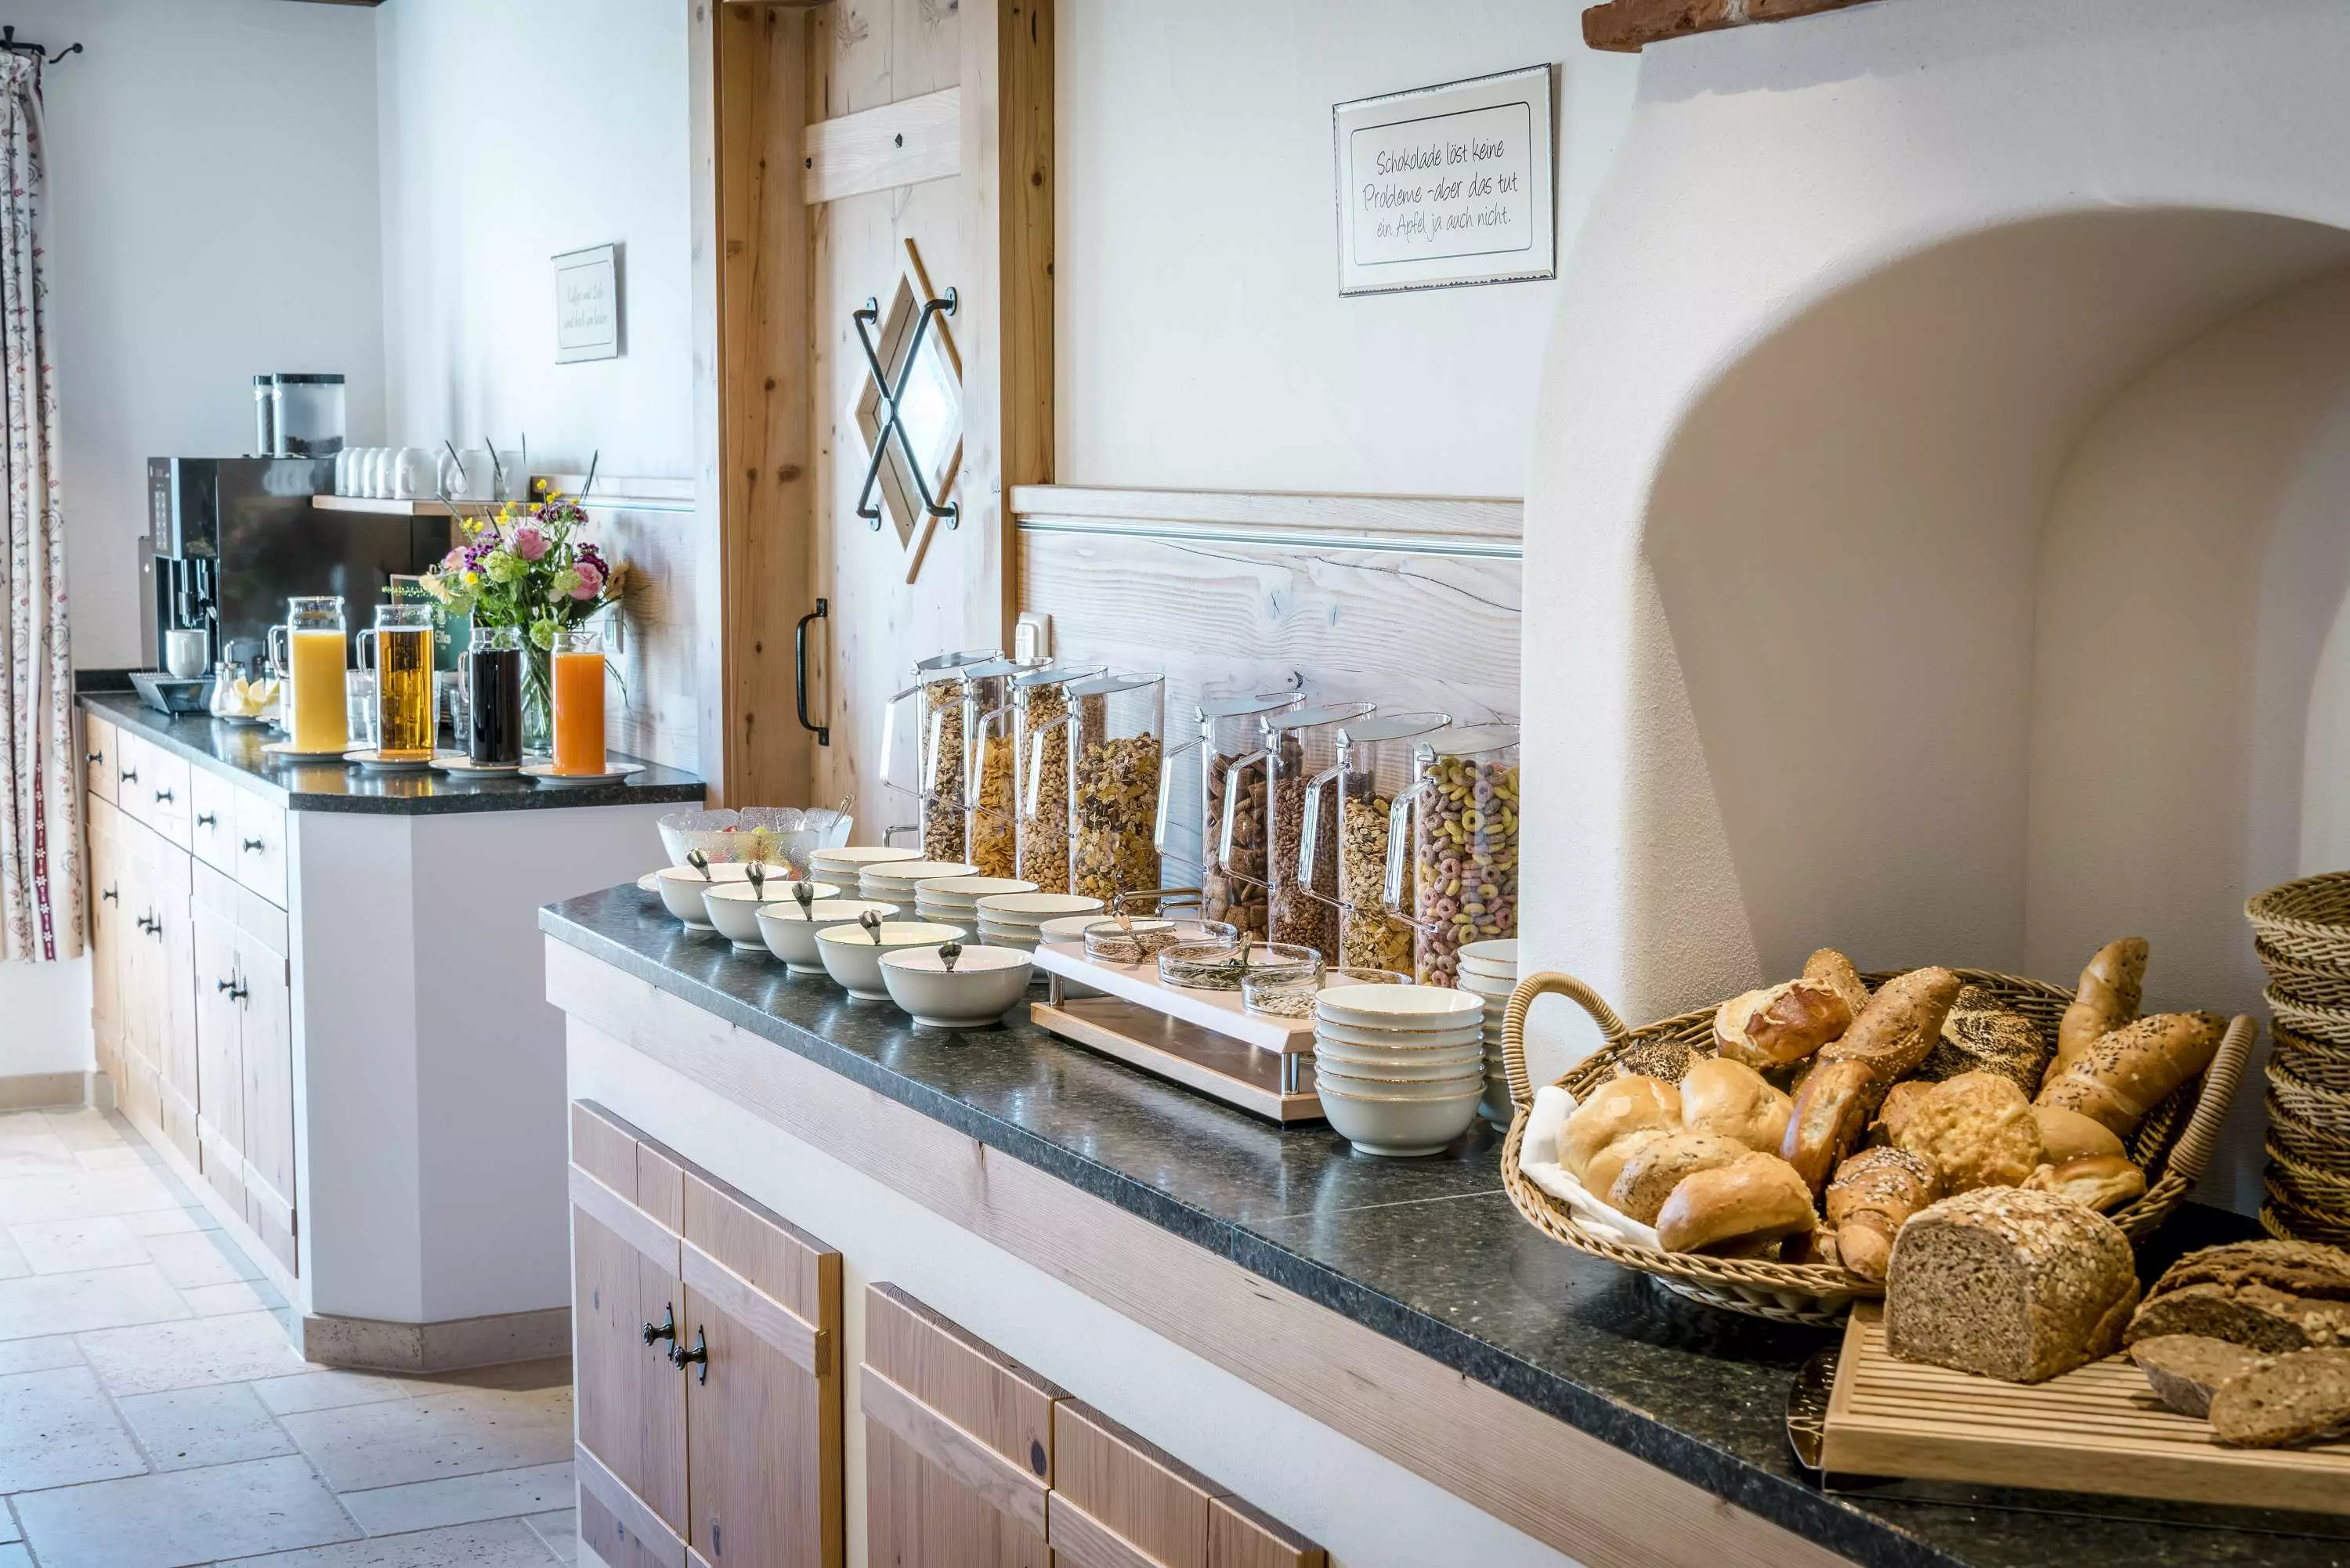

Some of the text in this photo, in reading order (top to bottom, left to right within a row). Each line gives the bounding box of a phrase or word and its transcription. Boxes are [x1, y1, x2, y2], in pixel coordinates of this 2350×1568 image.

[1376, 137, 1505, 175] Schokolade löst keine
[1362, 182, 1423, 211] Probleme
[1468, 172, 1492, 197] das
[1497, 172, 1518, 193] tut
[1376, 201, 1511, 243] ein Apfel ja auch nicht.
